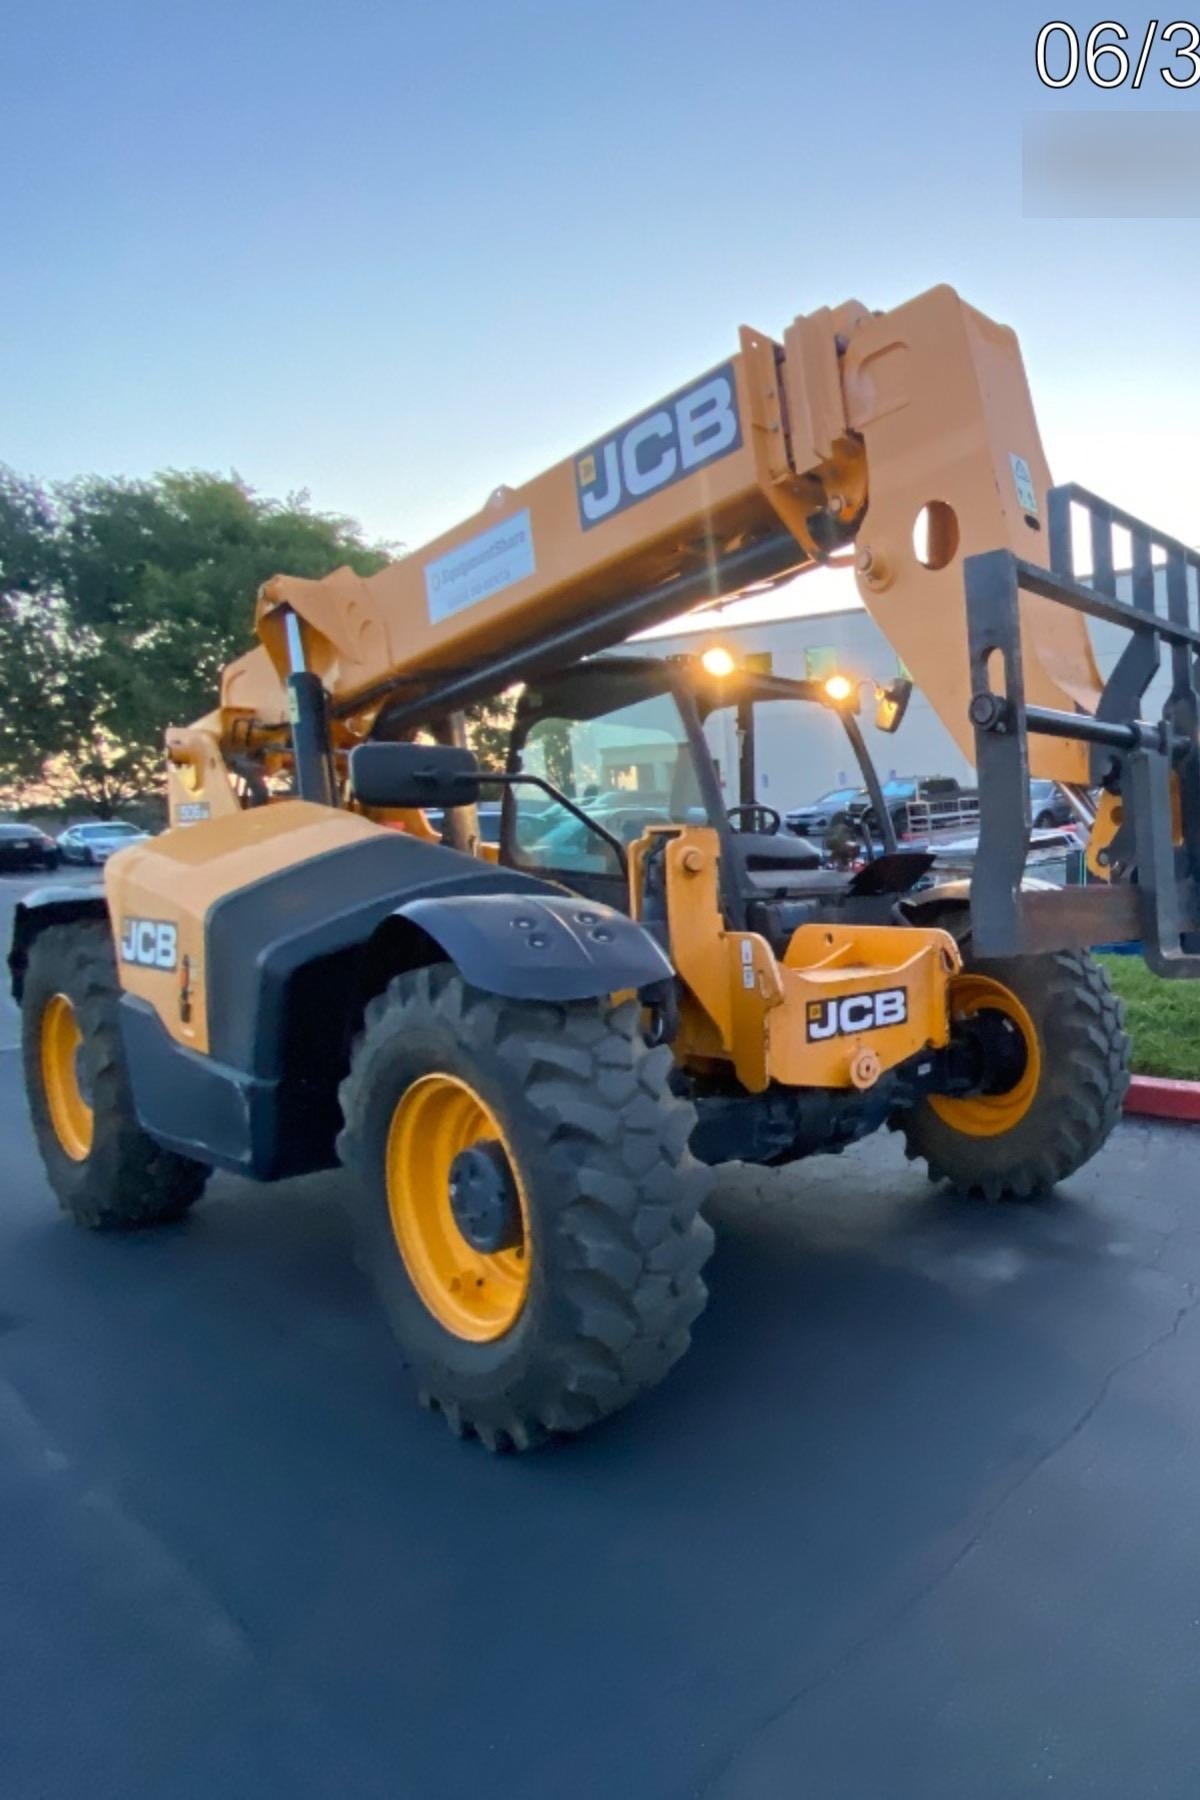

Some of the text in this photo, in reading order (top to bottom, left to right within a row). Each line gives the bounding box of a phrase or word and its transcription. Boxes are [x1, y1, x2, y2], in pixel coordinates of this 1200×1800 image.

[582, 376, 738, 521] JCB
[121, 919, 178, 969] JCB
[809, 989, 907, 1039] JCB
